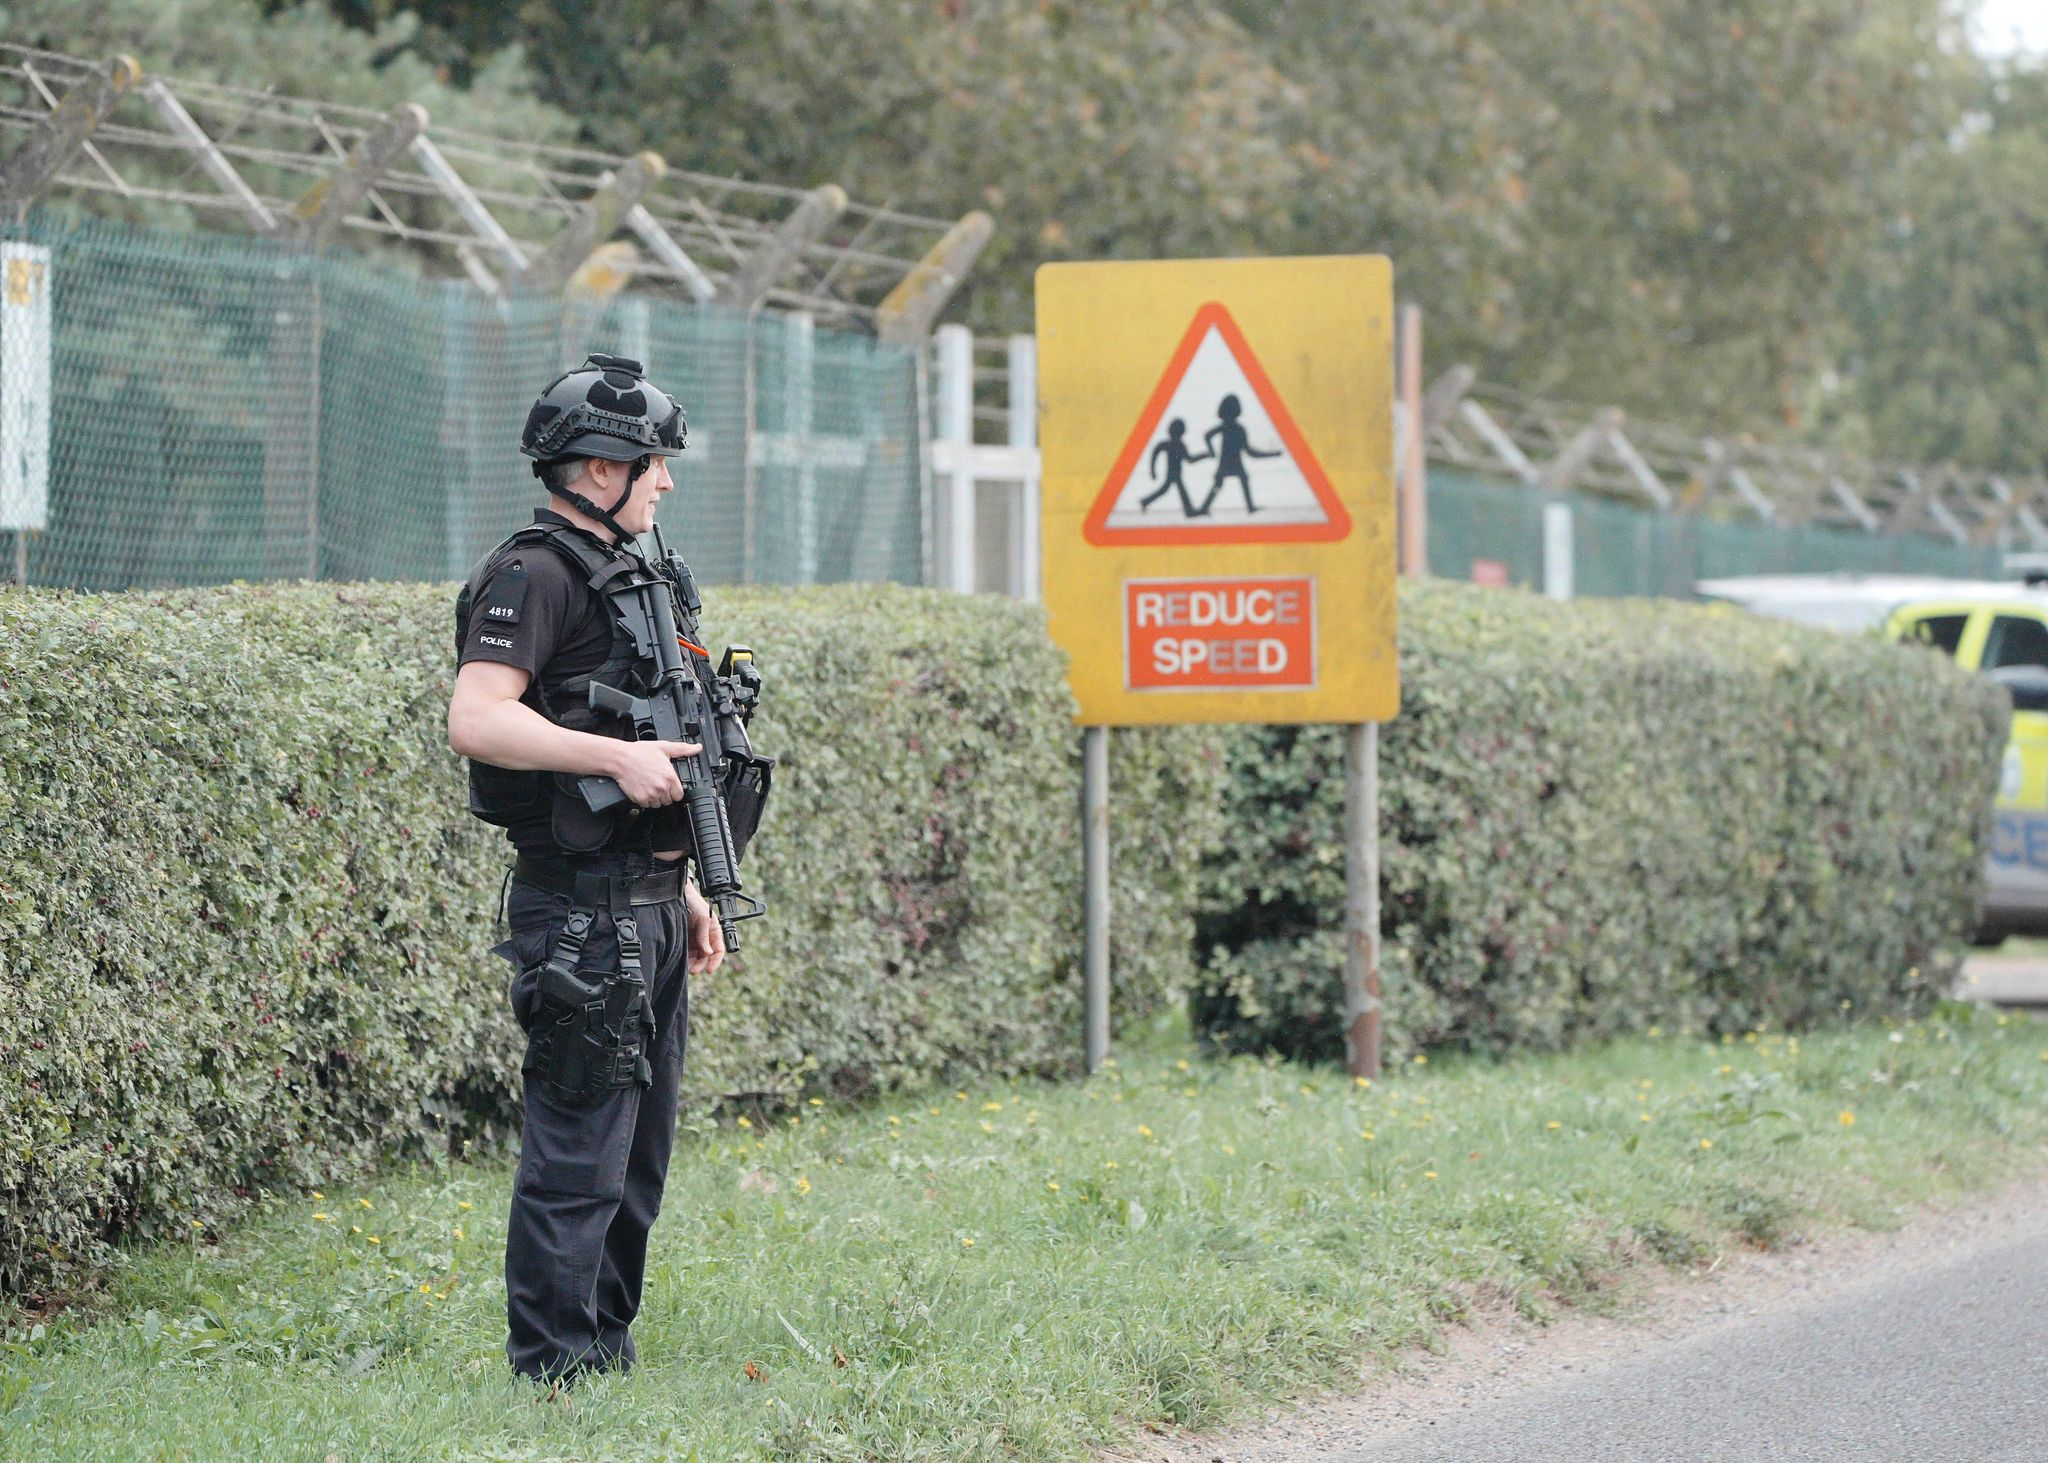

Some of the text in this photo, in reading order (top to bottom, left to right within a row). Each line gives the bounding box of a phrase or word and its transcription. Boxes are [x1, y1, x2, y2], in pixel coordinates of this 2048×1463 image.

[488, 606, 514, 617] 4819
[1136, 589, 1299, 627] REDUCE
[480, 636, 513, 648] POLICE
[1153, 637, 1288, 674] SPEED
